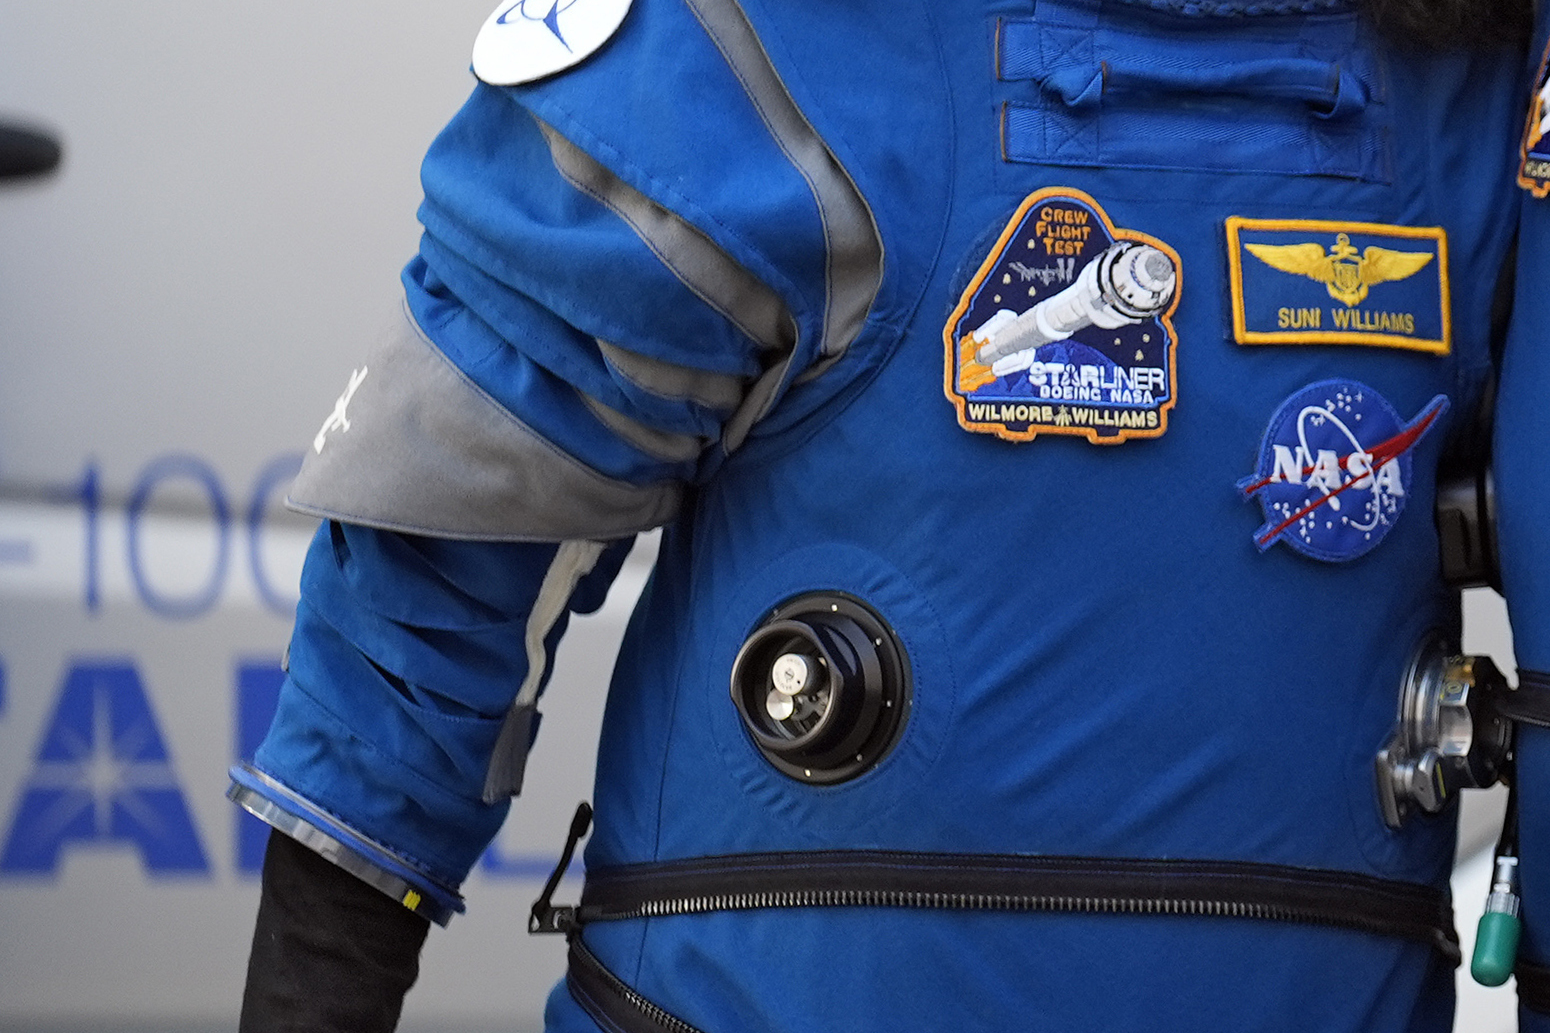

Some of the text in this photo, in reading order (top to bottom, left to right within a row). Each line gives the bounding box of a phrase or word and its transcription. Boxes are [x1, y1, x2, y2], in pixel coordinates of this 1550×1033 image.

[1041, 207, 1088, 225] CREW
[1036, 221, 1091, 241] FLIGHT
[1043, 237, 1084, 256] TEST
[1278, 307, 1414, 334] SUNI WILLIAMS
[1029, 361, 1165, 391] STARLINER
[1040, 385, 1154, 404] BOEING NASA
[969, 403, 1157, 427] WILMORE WILLIAMS
[1270, 444, 1404, 496] NASA
